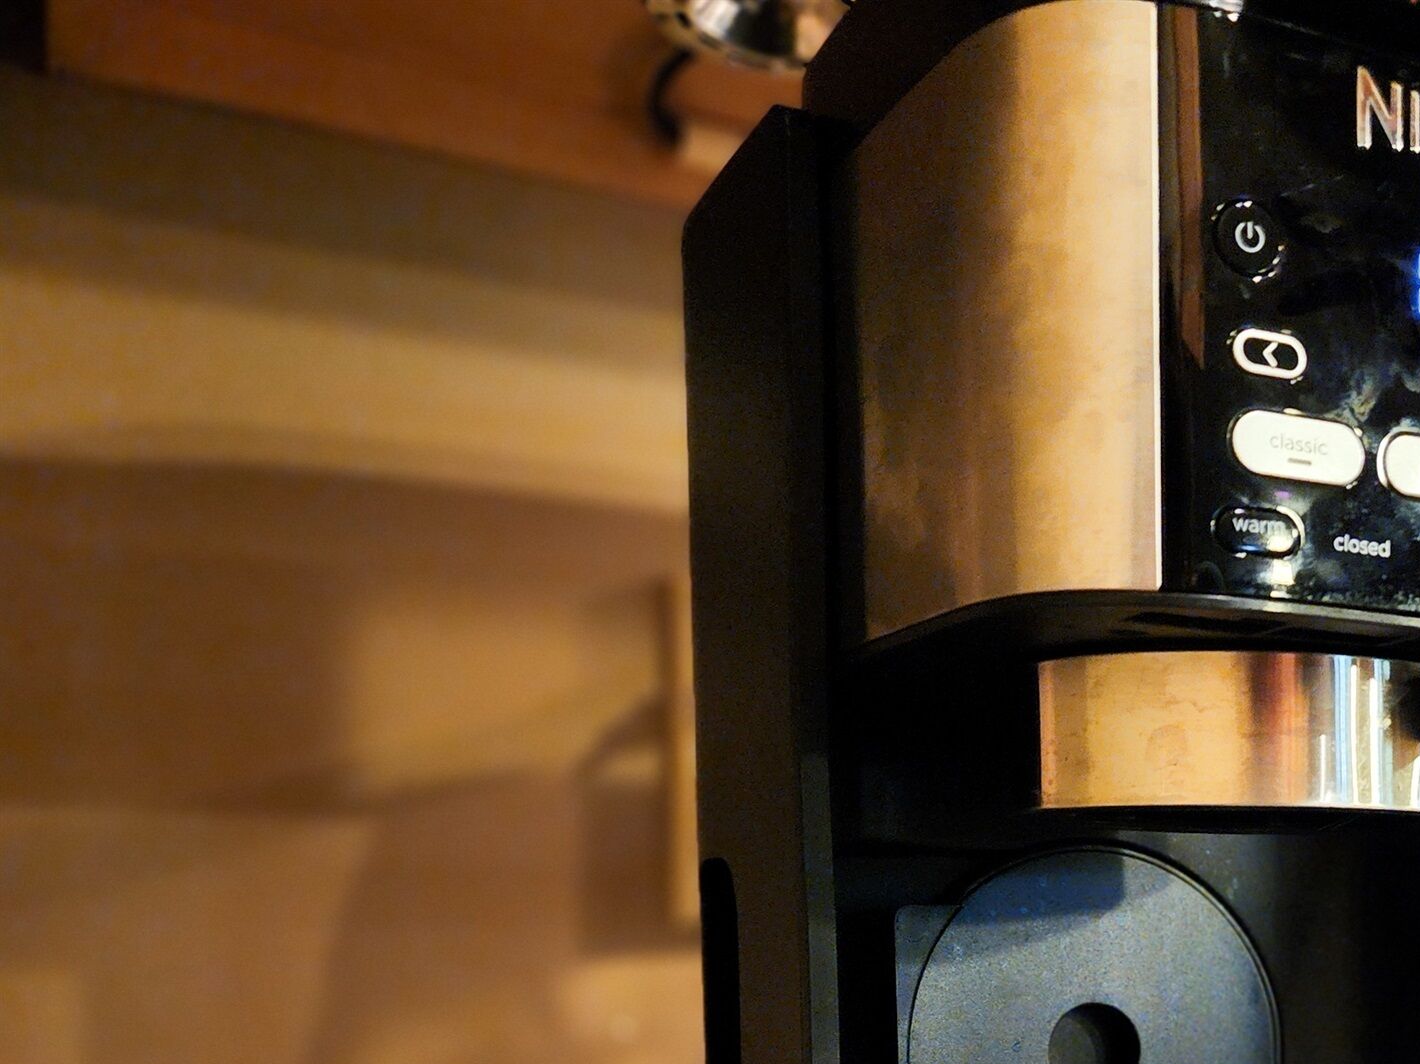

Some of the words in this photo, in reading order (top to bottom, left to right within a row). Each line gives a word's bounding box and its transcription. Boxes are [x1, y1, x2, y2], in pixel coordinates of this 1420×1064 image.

[1269, 432, 1328, 456] classic
[1232, 517, 1286, 536] warm
[1333, 533, 1391, 558] closed
